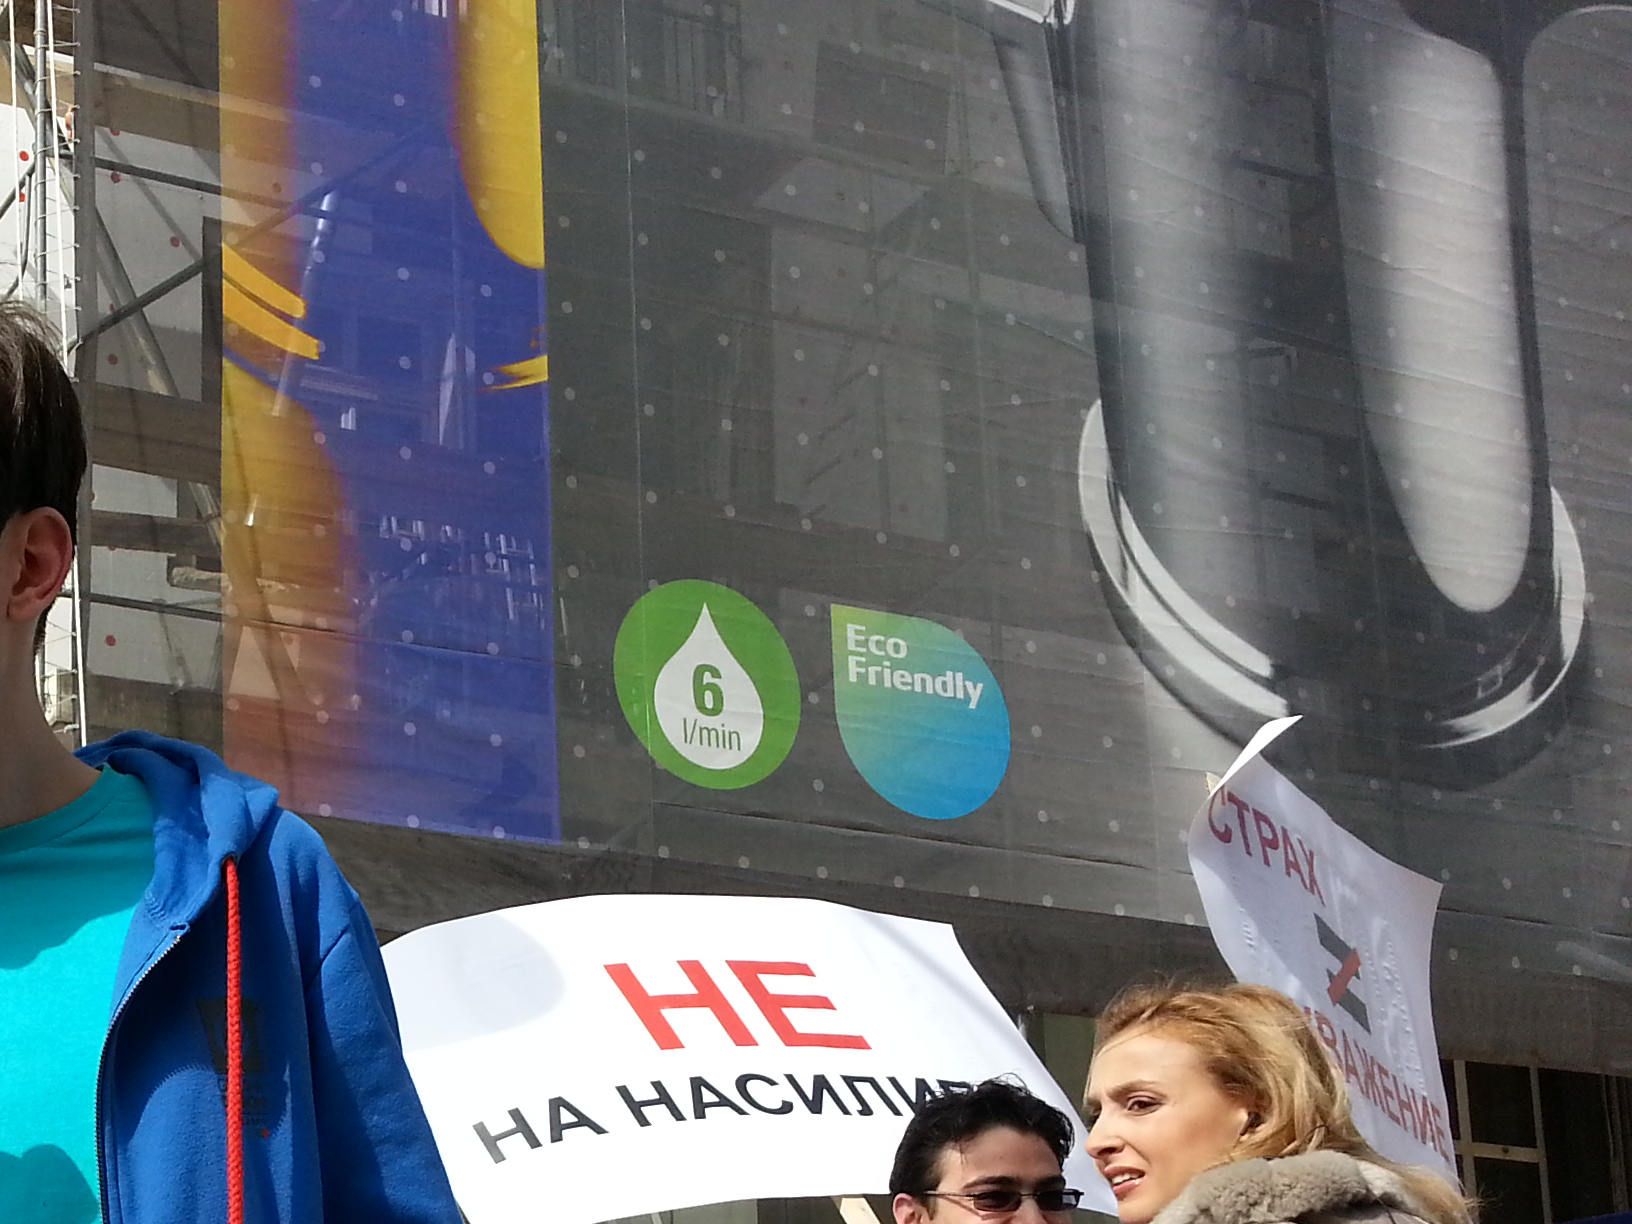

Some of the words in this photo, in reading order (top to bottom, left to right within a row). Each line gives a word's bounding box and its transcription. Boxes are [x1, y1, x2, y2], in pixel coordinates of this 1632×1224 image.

[846, 623, 908, 660] Eco
[691, 662, 725, 718] 6
[848, 656, 984, 710] Friendly
[682, 717, 742, 752] l/min
[1206, 787, 1326, 907] СТРАХ
[604, 959, 872, 1050] НЕ
[473, 1095, 608, 1165] НА
